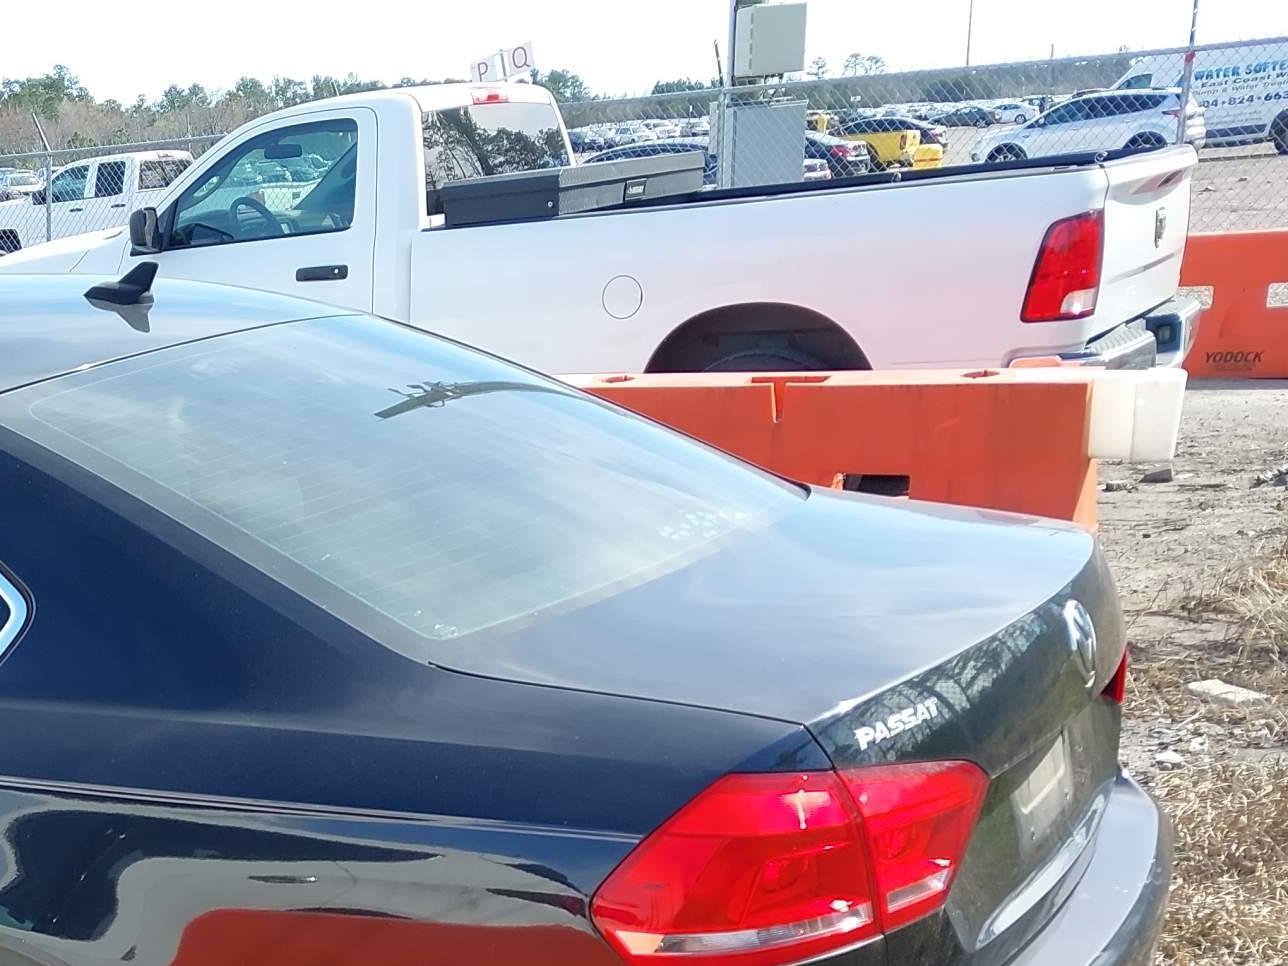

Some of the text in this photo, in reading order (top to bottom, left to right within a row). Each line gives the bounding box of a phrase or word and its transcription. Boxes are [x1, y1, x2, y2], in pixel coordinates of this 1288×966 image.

[512, 46, 531, 69] Q
[477, 61, 488, 82] P
[1194, 60, 1288, 81] WATER SOFTE
[1206, 351, 1264, 363] YODOCK
[854, 696, 938, 751] PASSAT
